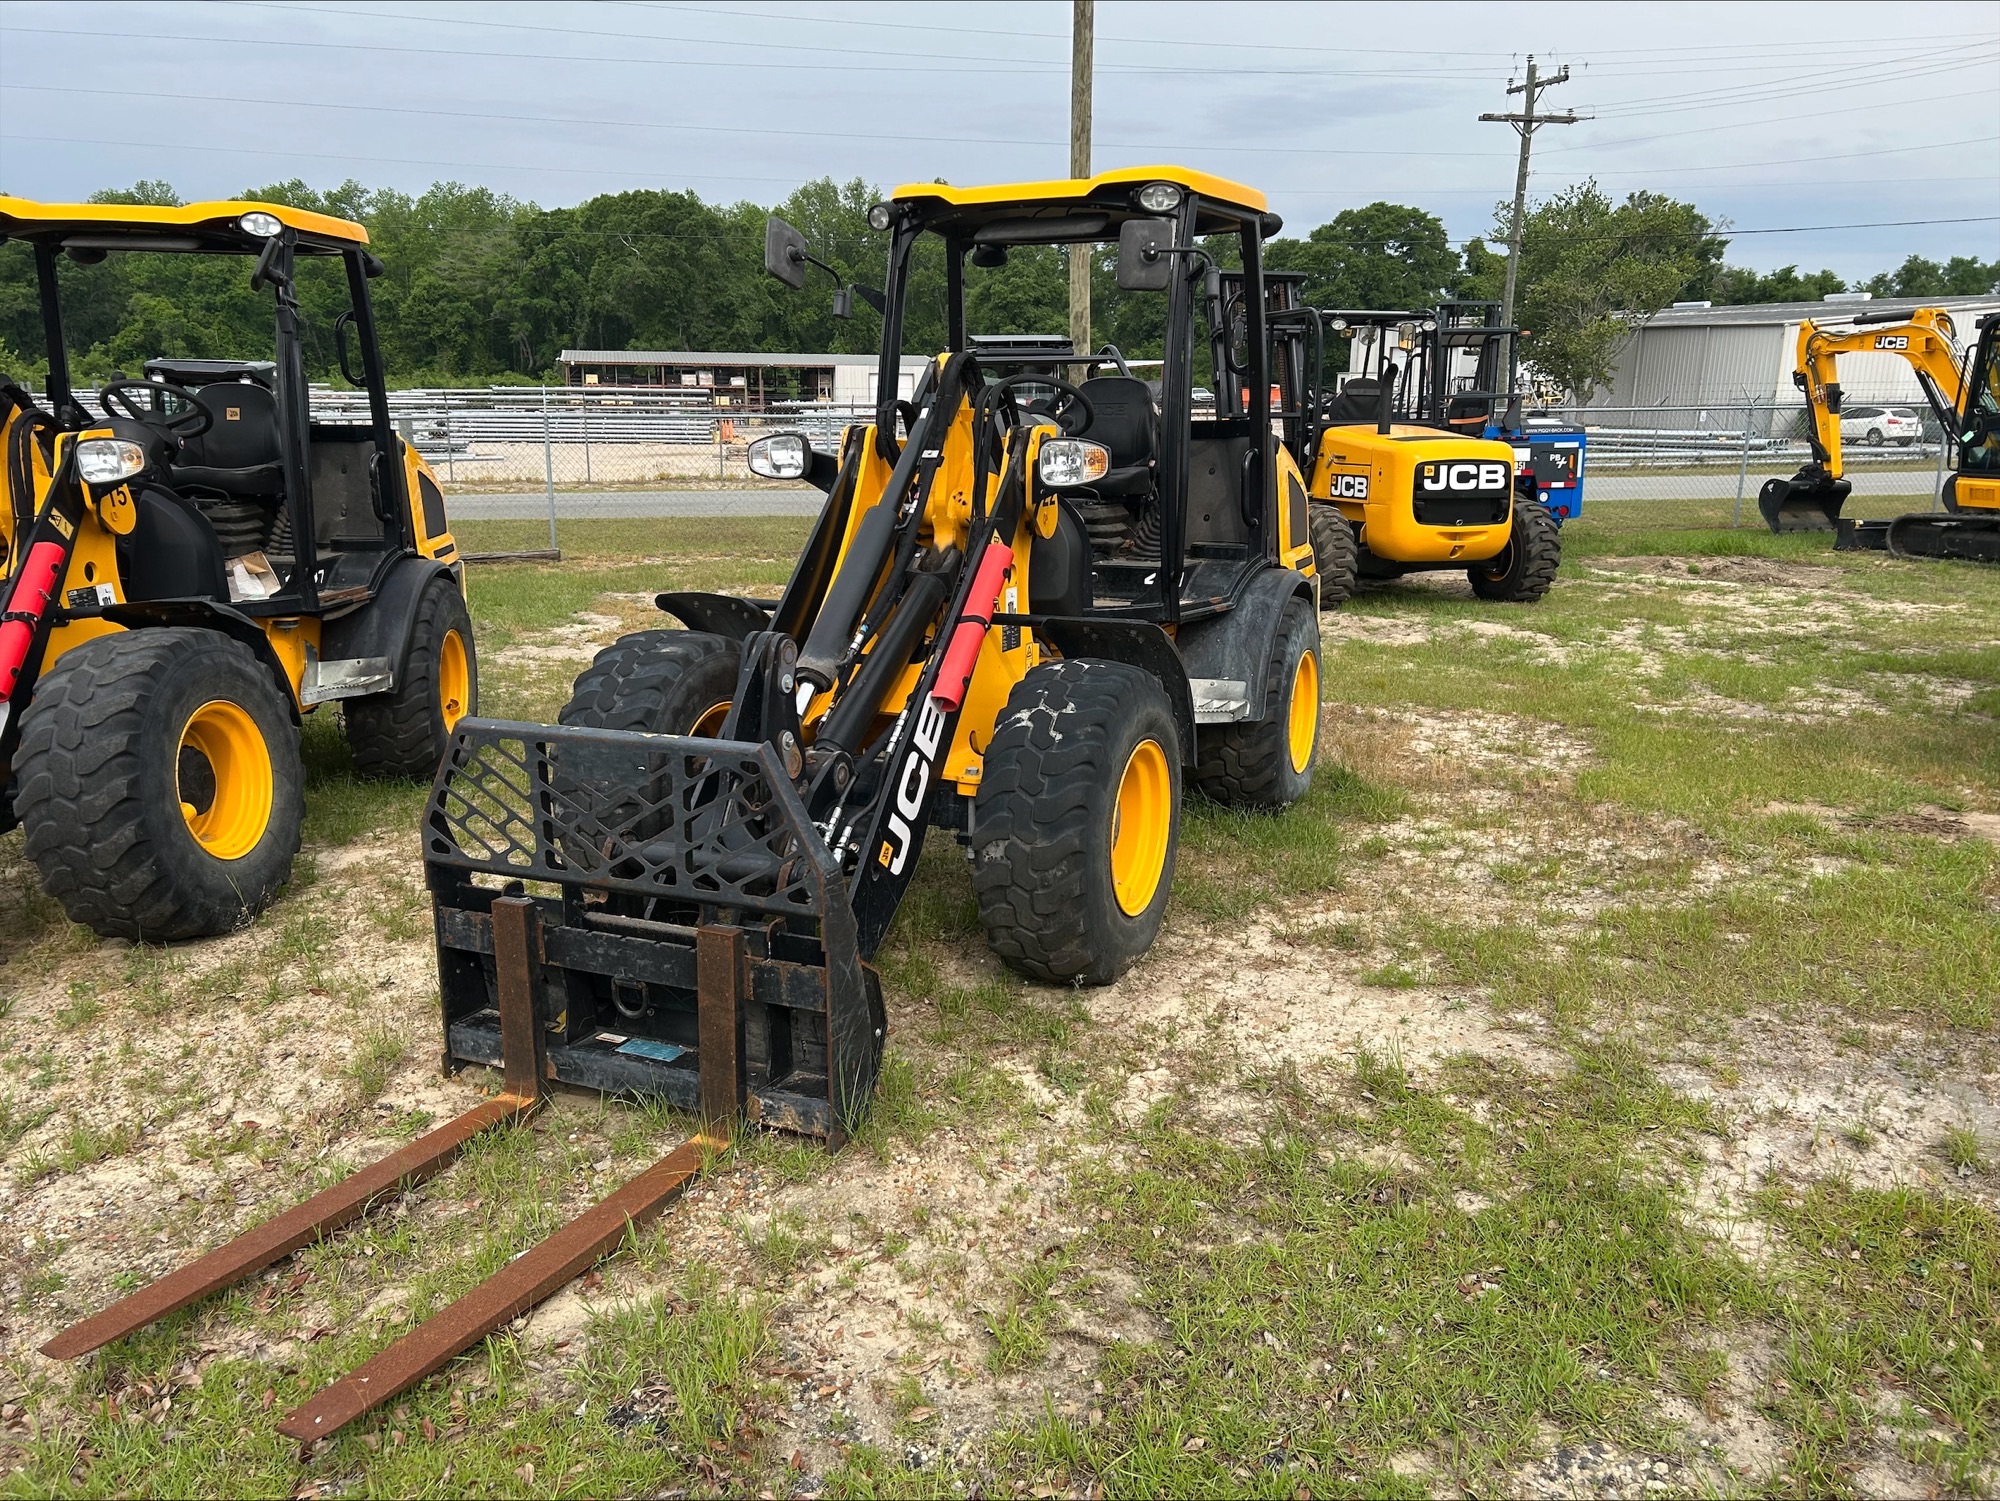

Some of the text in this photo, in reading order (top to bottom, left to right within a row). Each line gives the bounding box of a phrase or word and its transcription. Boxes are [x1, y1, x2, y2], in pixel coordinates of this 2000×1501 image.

[1875, 336, 1908, 349] JCB
[1331, 475, 1368, 498] JCB
[1423, 464, 1506, 491] JCB
[888, 691, 947, 876] JCB
